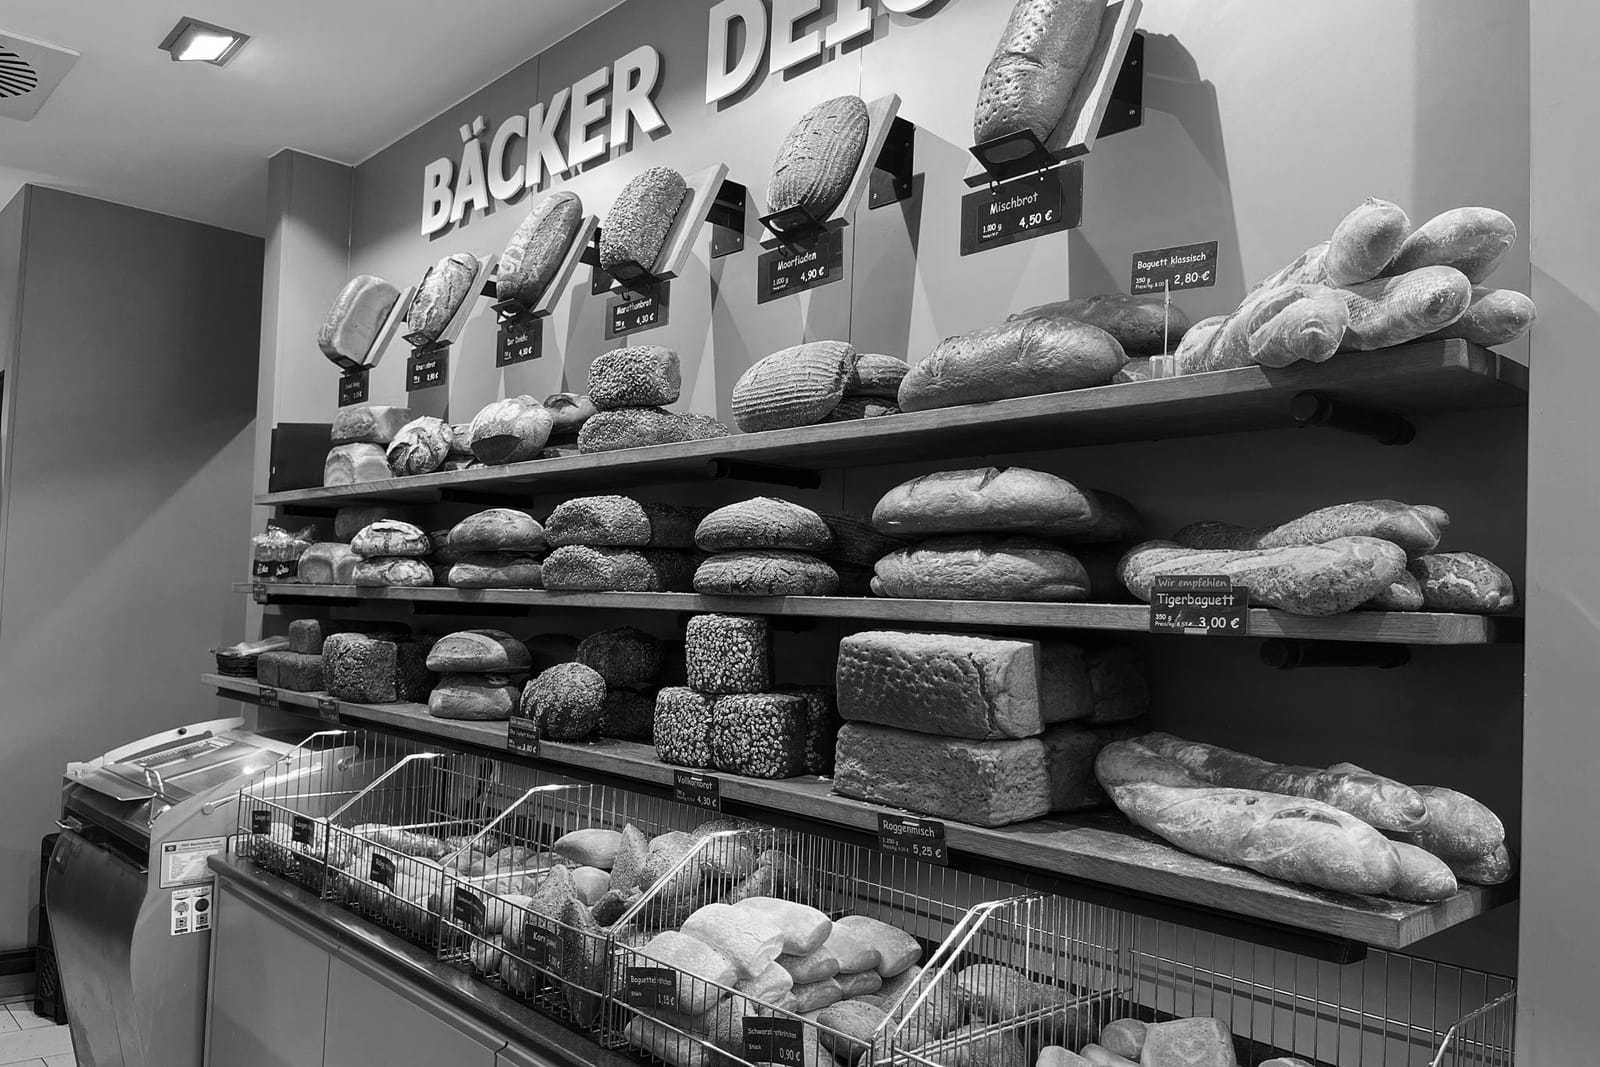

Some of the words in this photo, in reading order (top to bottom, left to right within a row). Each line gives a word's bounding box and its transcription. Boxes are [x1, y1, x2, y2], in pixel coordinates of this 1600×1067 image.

[421, 45, 666, 236] BÄCKER
[989, 191, 1039, 215] Mischbrot
[1018, 212, 1042, 229] 4,50
[1044, 209, 1053, 221] €
[777, 251, 818, 271] Moorfladen
[1137, 258, 1168, 271] Baguett
[1170, 251, 1207, 265] klassisch
[801, 268, 817, 282] 4,90
[818, 265, 825, 277] €
[1173, 272, 1199, 286] 2,80
[1201, 270, 1211, 281] €
[1157, 578, 1176, 588] Wir
[1178, 577, 1228, 591] empfehlen
[1156, 592, 1236, 608] Tigerbaguett
[1199, 616, 1227, 630] 3,00
[1230, 617, 1241, 629] €
[882, 819, 936, 838] Roggenmisch
[912, 843, 933, 857] 5,25
[935, 848, 942, 858] €
[779, 1047, 794, 1061] 0,90
[795, 1050, 802, 1062] €
